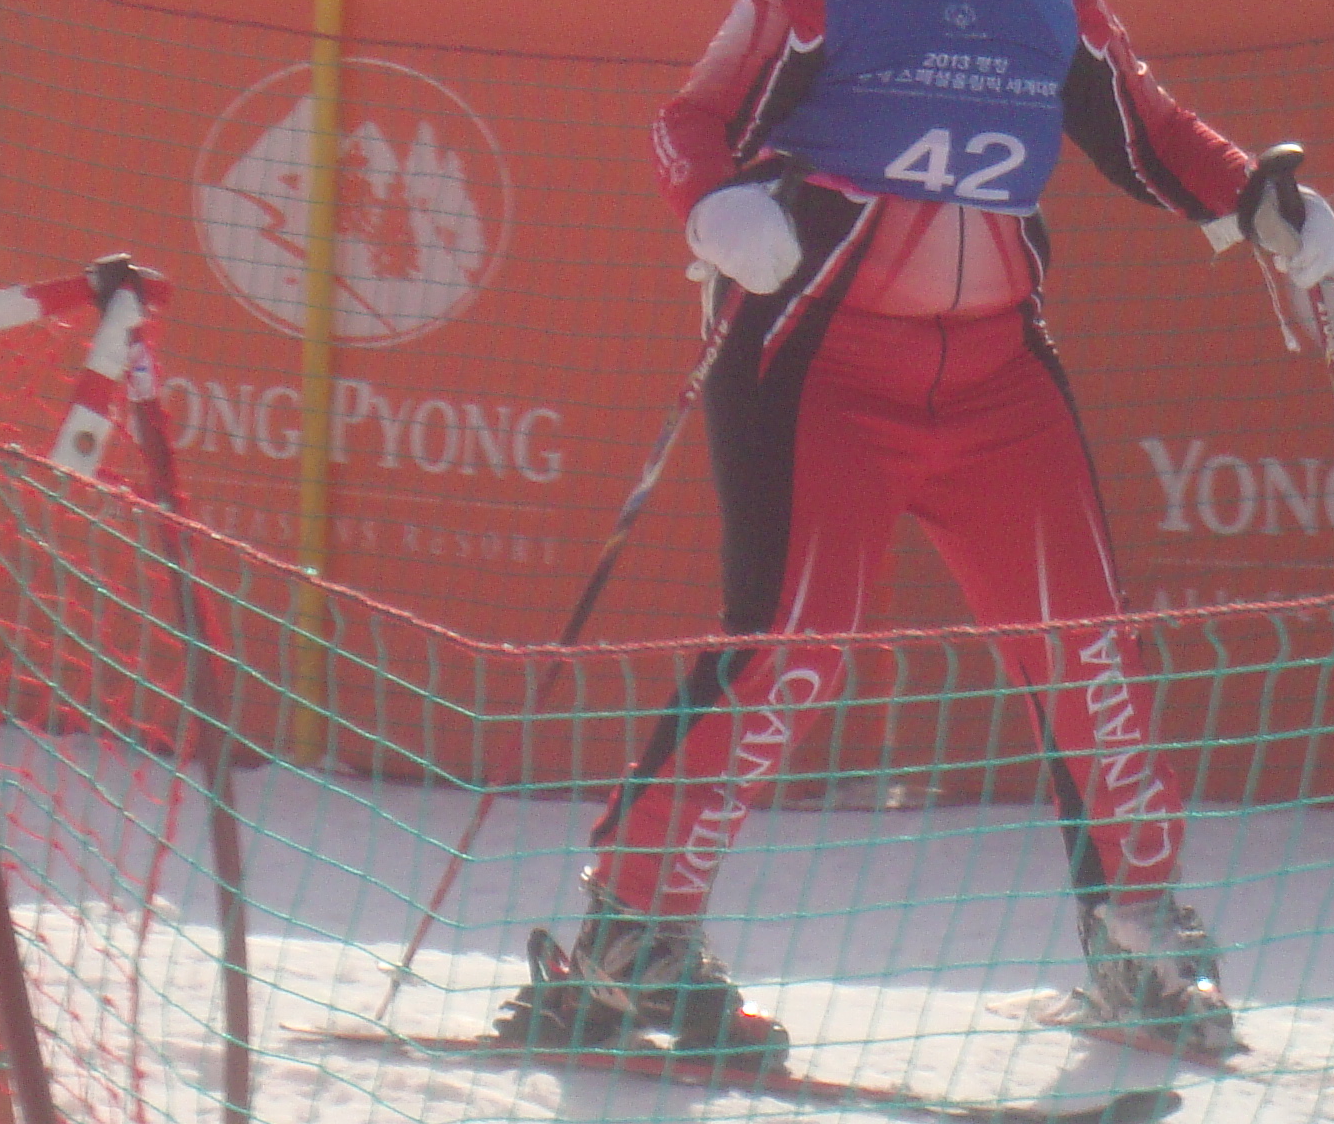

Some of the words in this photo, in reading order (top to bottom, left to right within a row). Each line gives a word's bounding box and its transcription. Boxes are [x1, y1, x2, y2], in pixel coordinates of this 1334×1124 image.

[922, 52, 970, 70] 2013
[883, 128, 1026, 201] 42
[135, 376, 302, 460] ONG
[329, 379, 563, 484] PYONG
[664, 667, 823, 895] CANADA
[1078, 626, 1173, 869] CANADA
